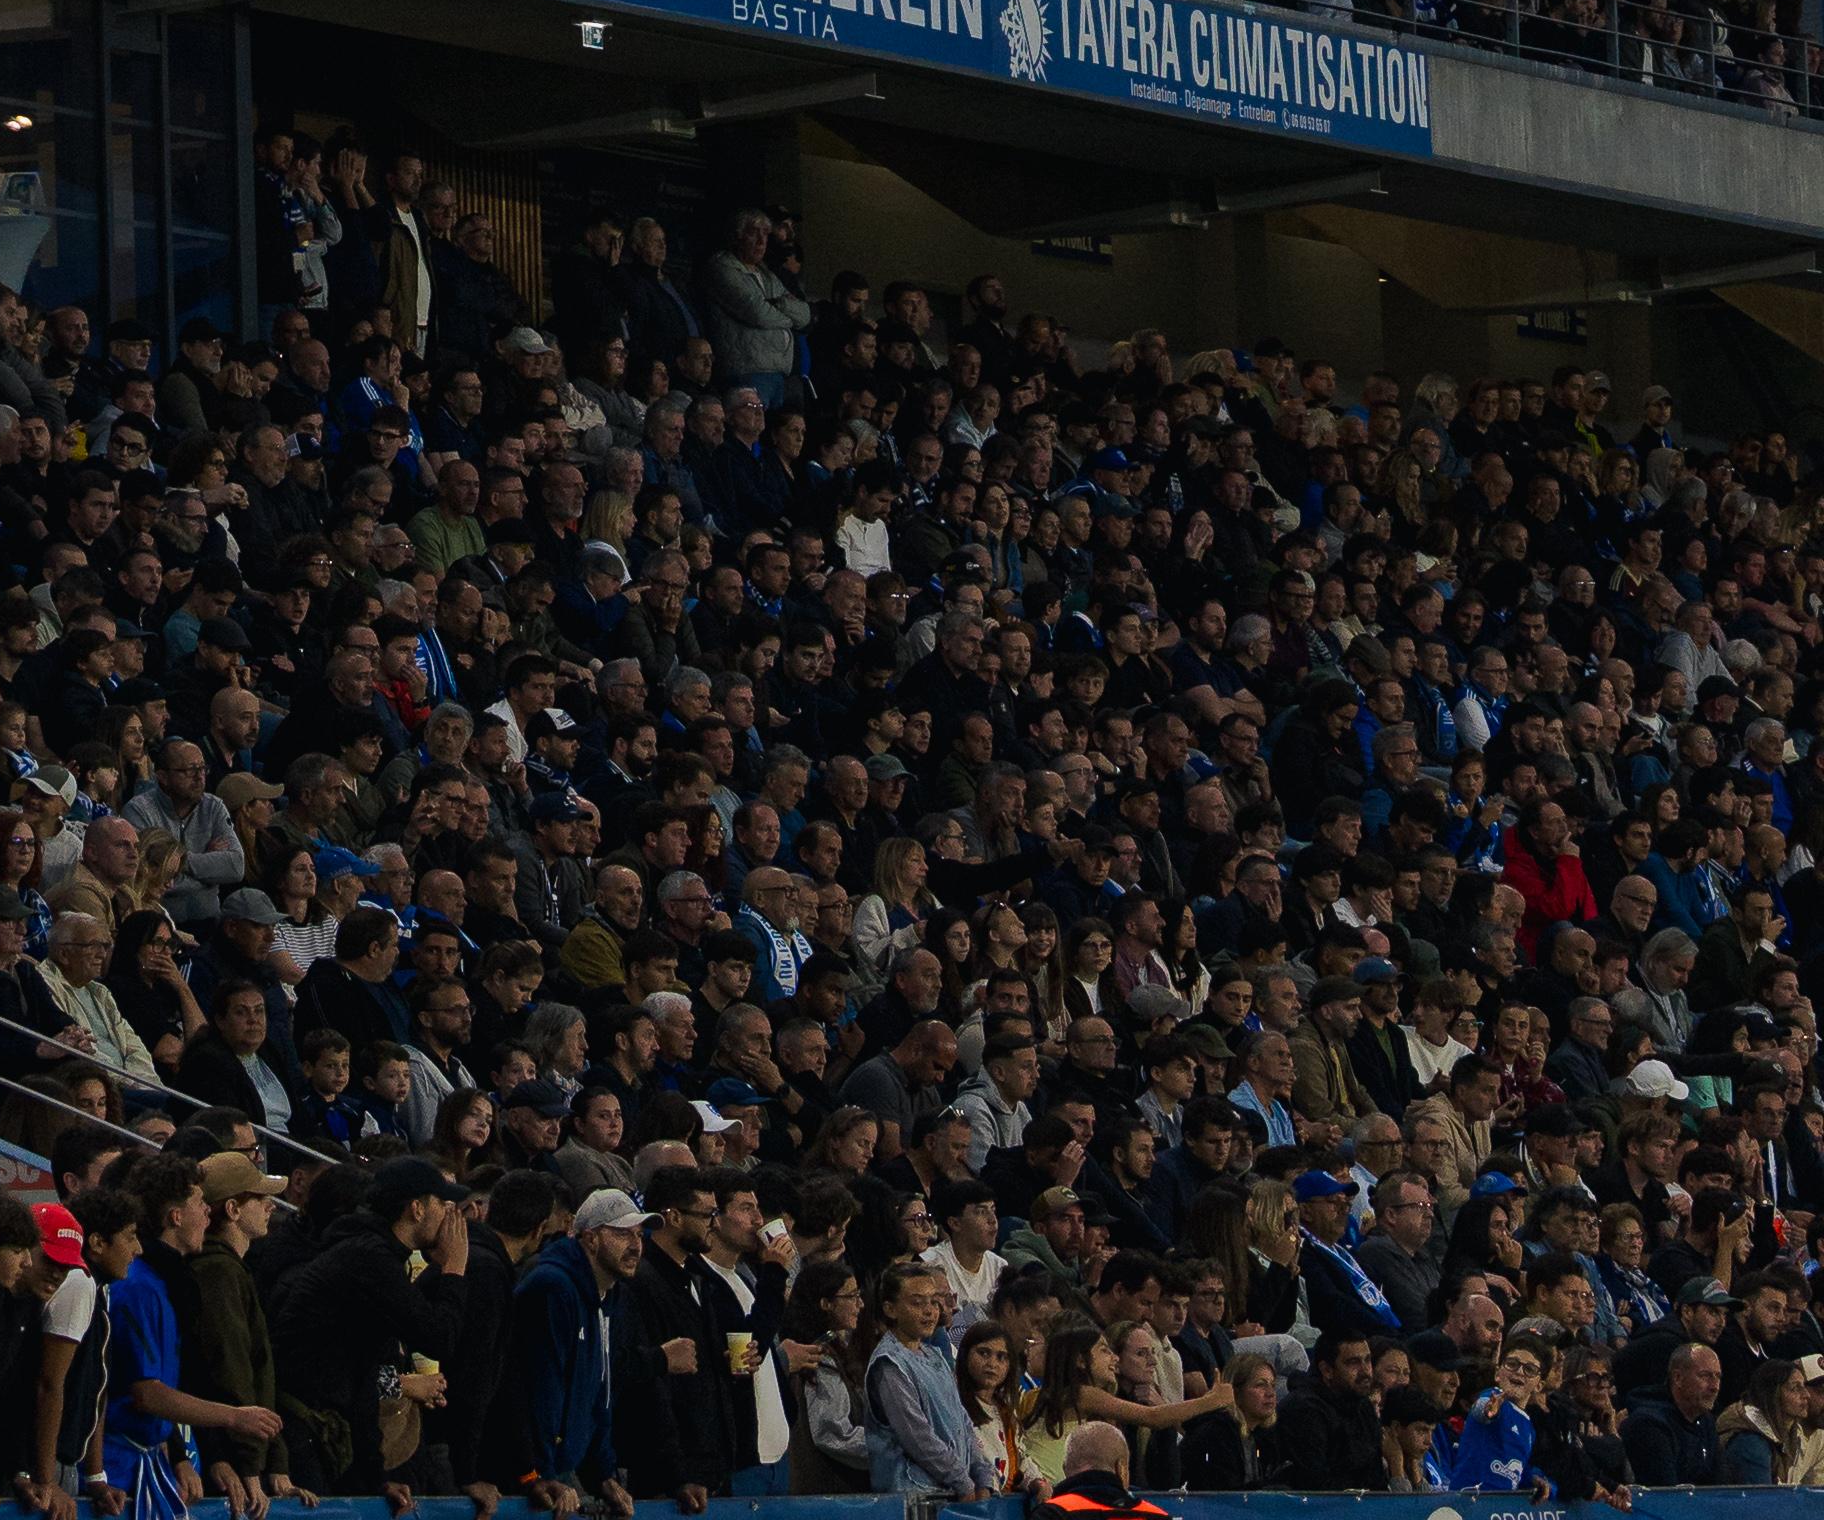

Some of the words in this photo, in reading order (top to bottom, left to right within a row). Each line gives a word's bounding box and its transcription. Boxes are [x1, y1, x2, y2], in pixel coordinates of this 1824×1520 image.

[1130, 78, 1178, 105] Installation
[1184, 89, 1232, 120] Dépannage
[1238, 99, 1277, 123] Entretien
[1189, 9, 1430, 129] CLIMATISATION
